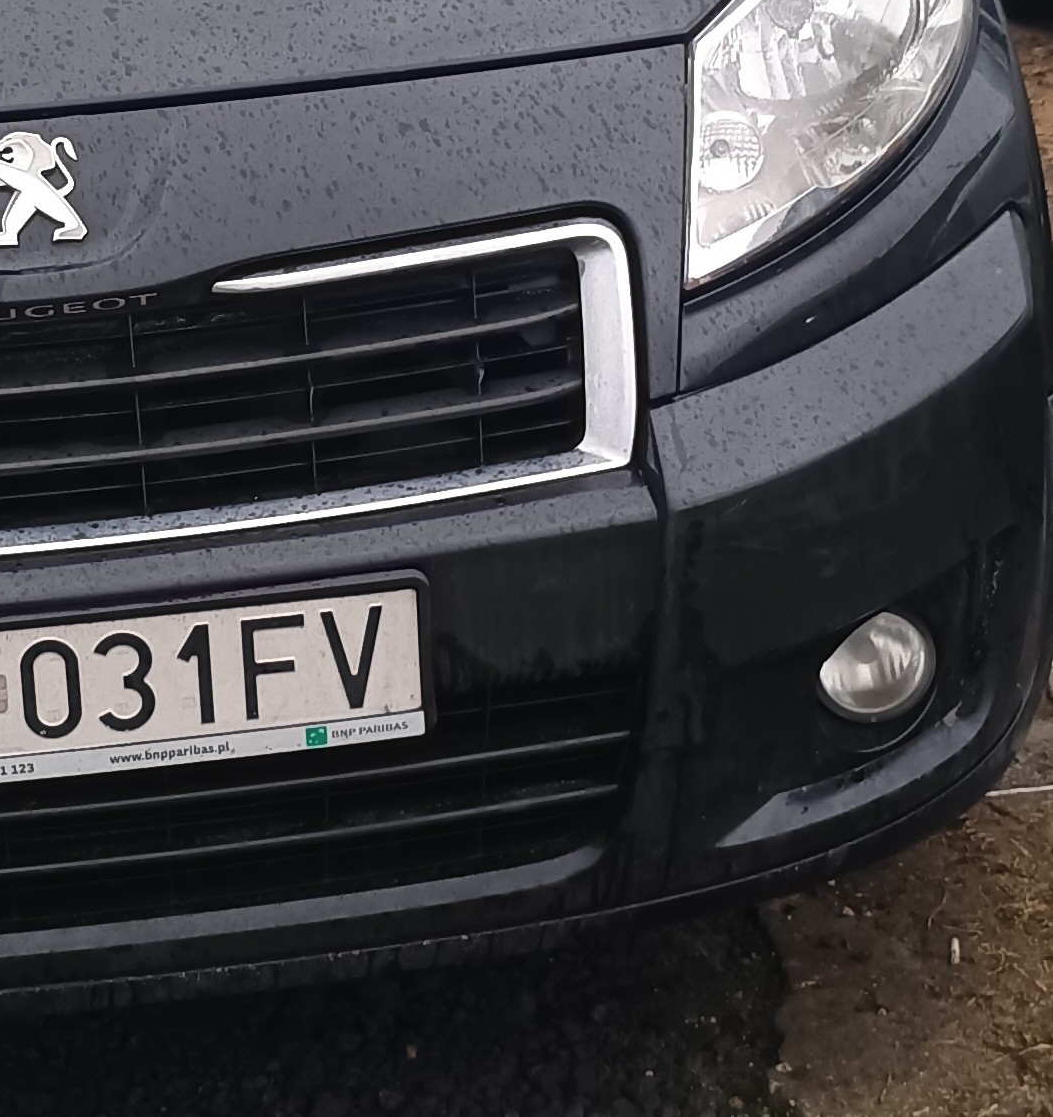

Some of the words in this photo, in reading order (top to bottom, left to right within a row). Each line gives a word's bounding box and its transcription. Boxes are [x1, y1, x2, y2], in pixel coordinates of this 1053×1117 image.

[19, 604, 383, 740] 031FV
[331, 727, 356, 739] BNP
[357, 720, 409, 736] PARIBAS
[109, 740, 231, 765] www.bnpparibas.pl
[11, 763, 35, 776] 123
